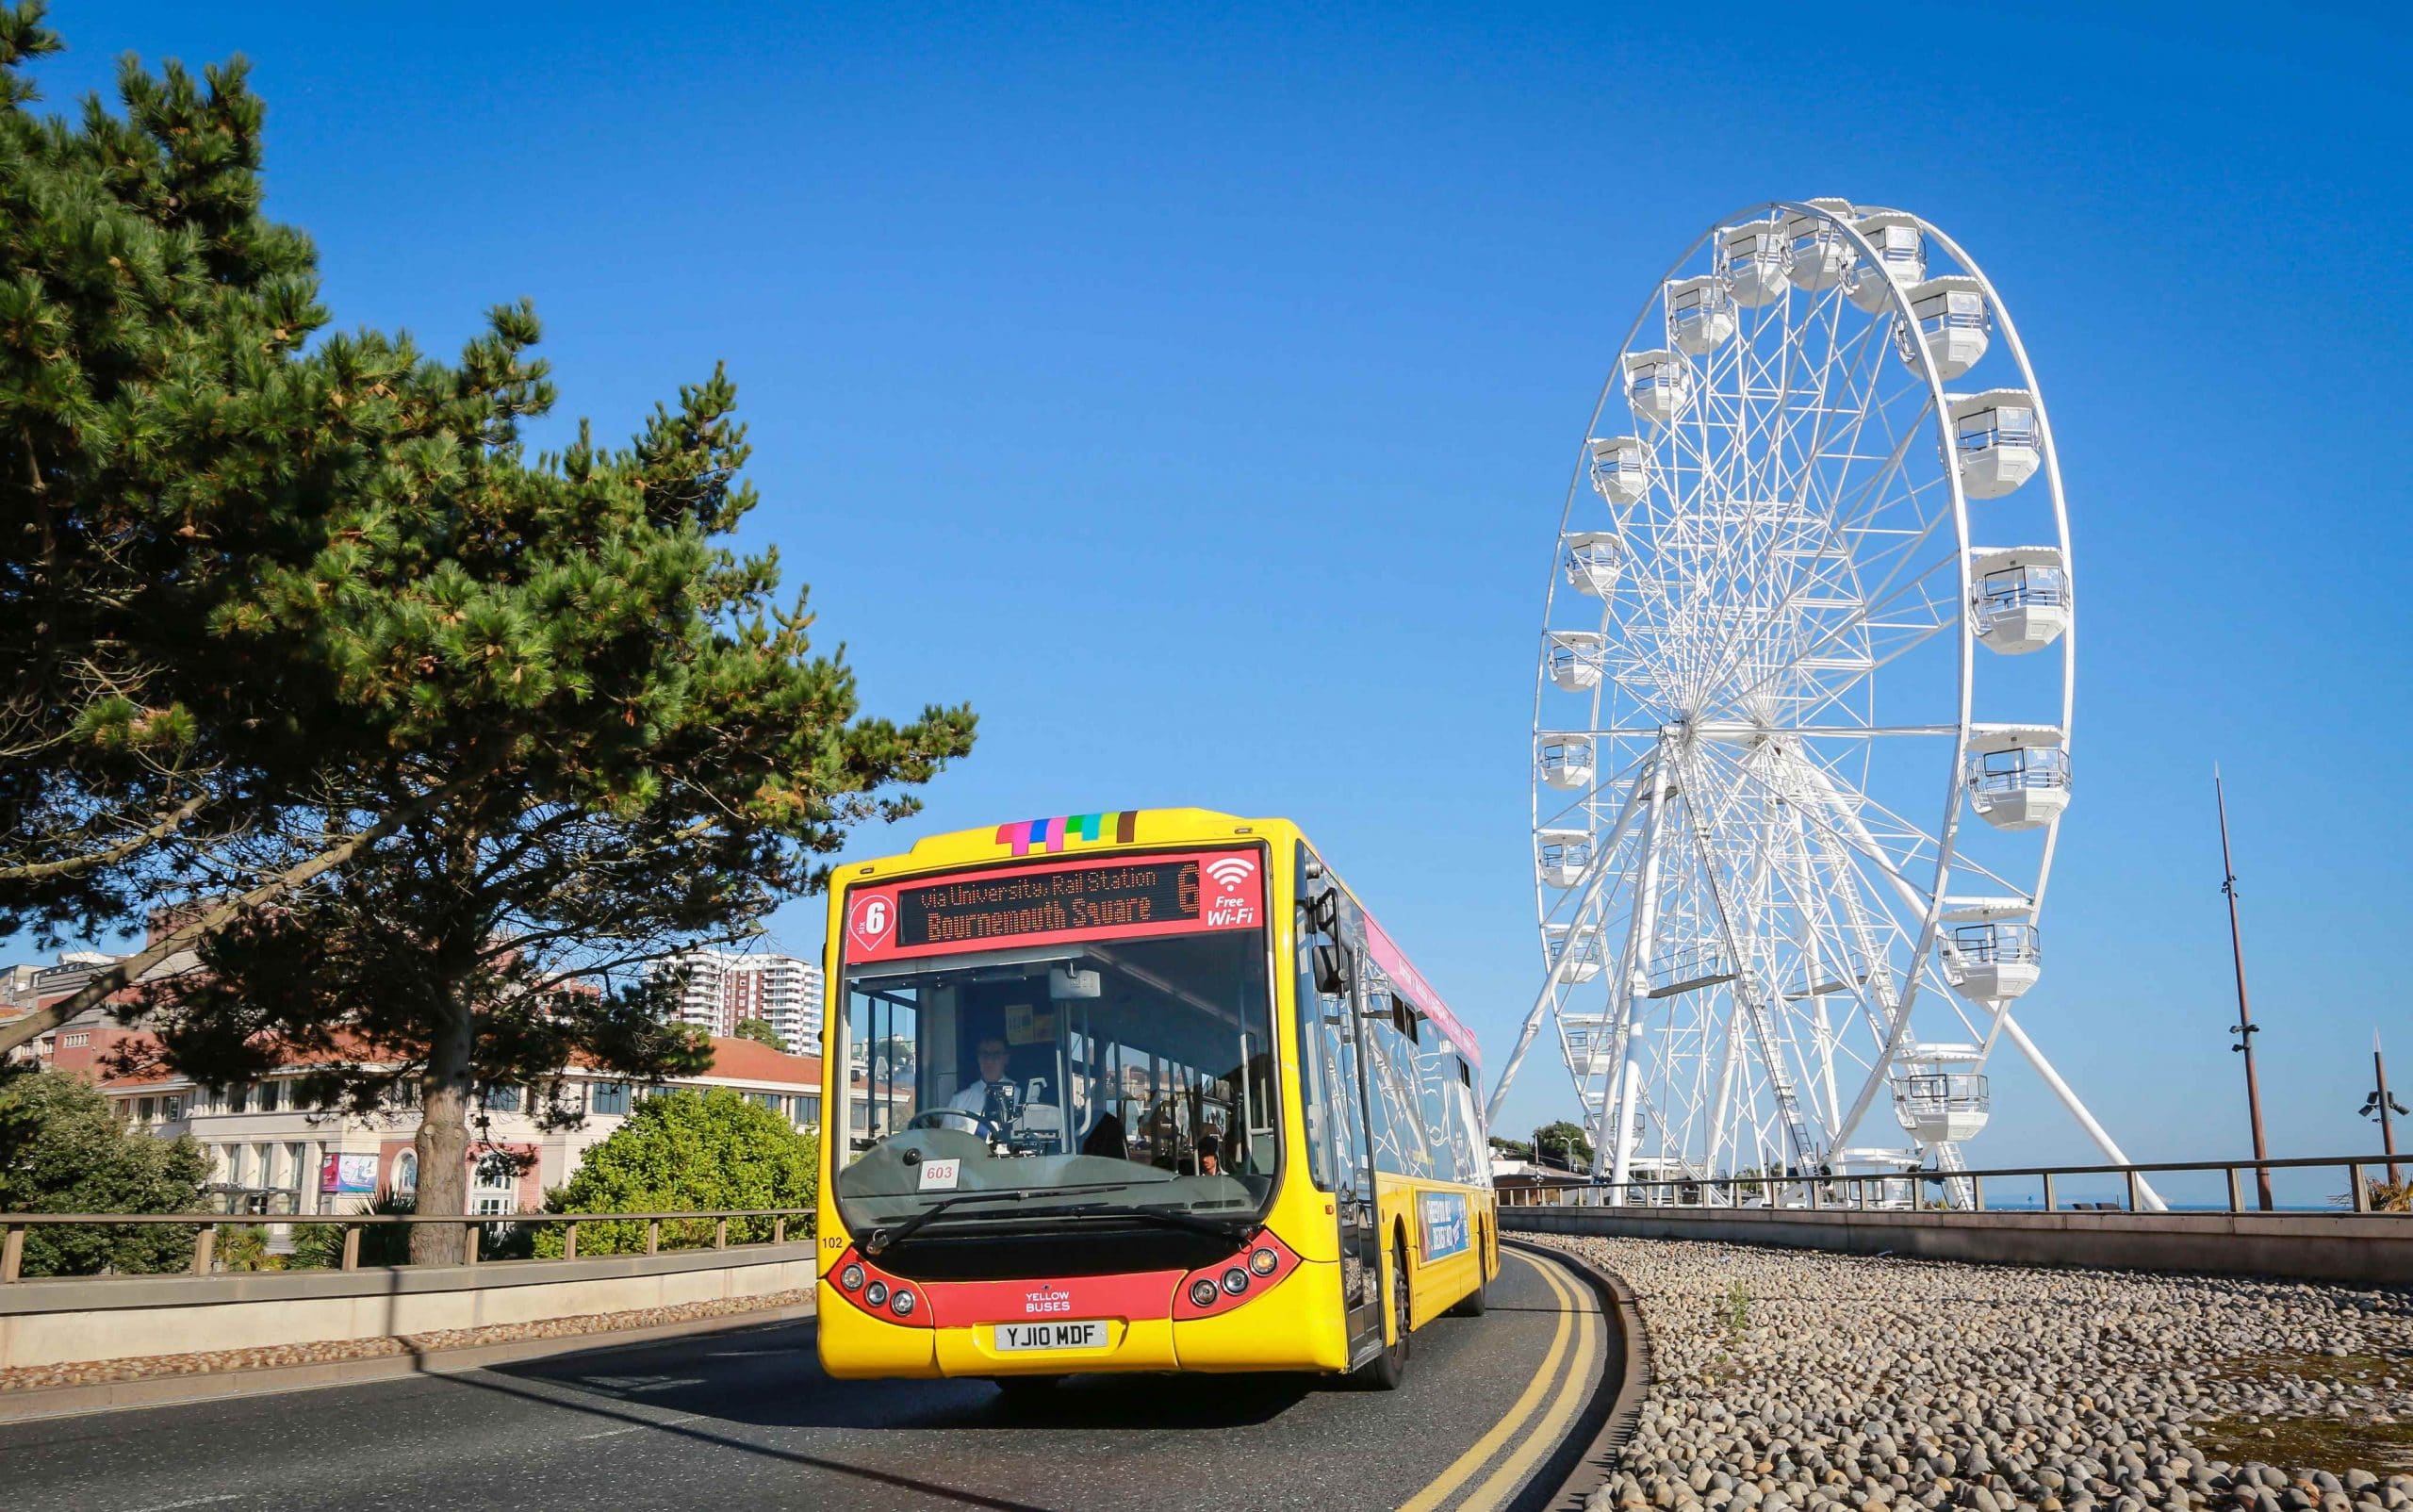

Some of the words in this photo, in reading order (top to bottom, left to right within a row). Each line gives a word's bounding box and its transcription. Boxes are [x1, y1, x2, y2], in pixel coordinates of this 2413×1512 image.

[921, 889, 946, 909] via
[1053, 874, 1083, 896] Rail
[1087, 867, 1157, 893] Station
[1178, 863, 1199, 913] 6
[1215, 896, 1244, 908] Free
[865, 901, 886, 935] 6
[927, 899, 1067, 941] Bournemouth
[1072, 896, 1152, 928] Square
[1207, 907, 1254, 927] Wi-Fi
[927, 1166, 953, 1179] 603
[822, 1237, 843, 1249] 102
[1026, 1291, 1070, 1301] YELLOW
[1026, 1301, 1071, 1313] BUSES
[1007, 1326, 1051, 1347] YJ10
[1056, 1324, 1095, 1346] MDF
